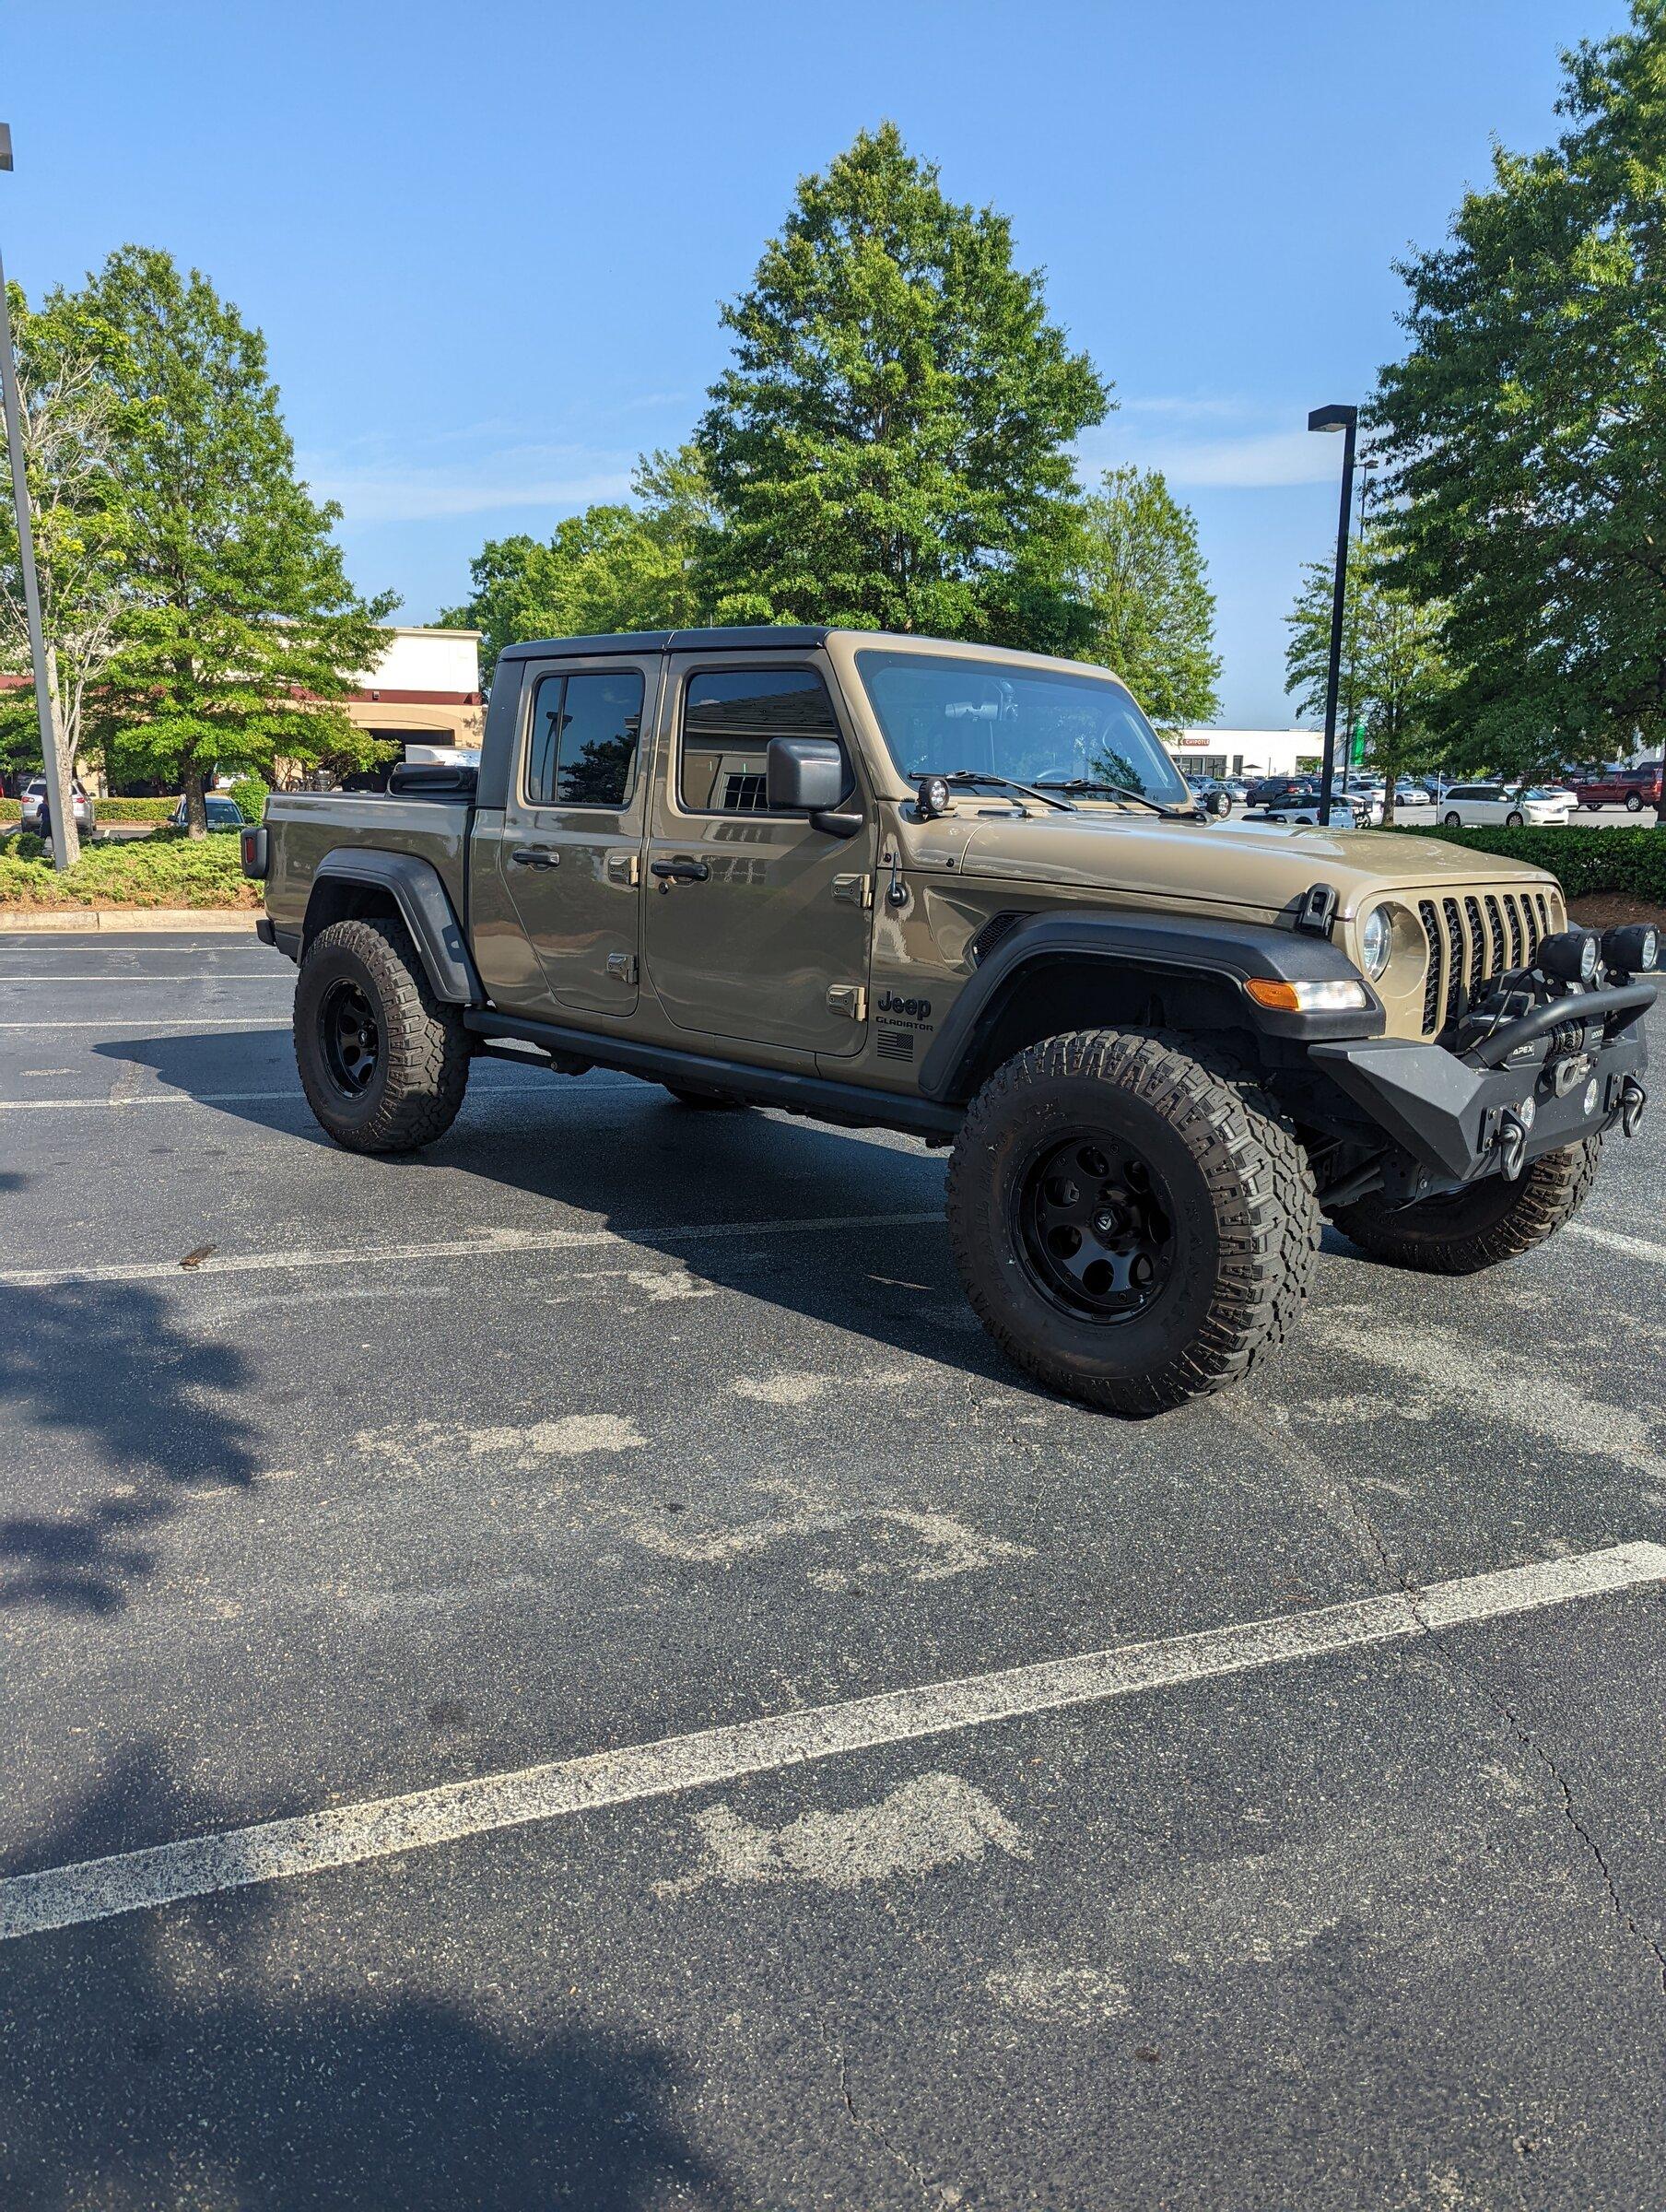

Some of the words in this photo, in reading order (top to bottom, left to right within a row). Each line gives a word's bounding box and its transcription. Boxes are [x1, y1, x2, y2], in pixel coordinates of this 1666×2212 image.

[877, 991, 932, 1021] Jeep
[875, 1016, 933, 1032] GLADIATOR
[1512, 1044, 1534, 1055] APEX
